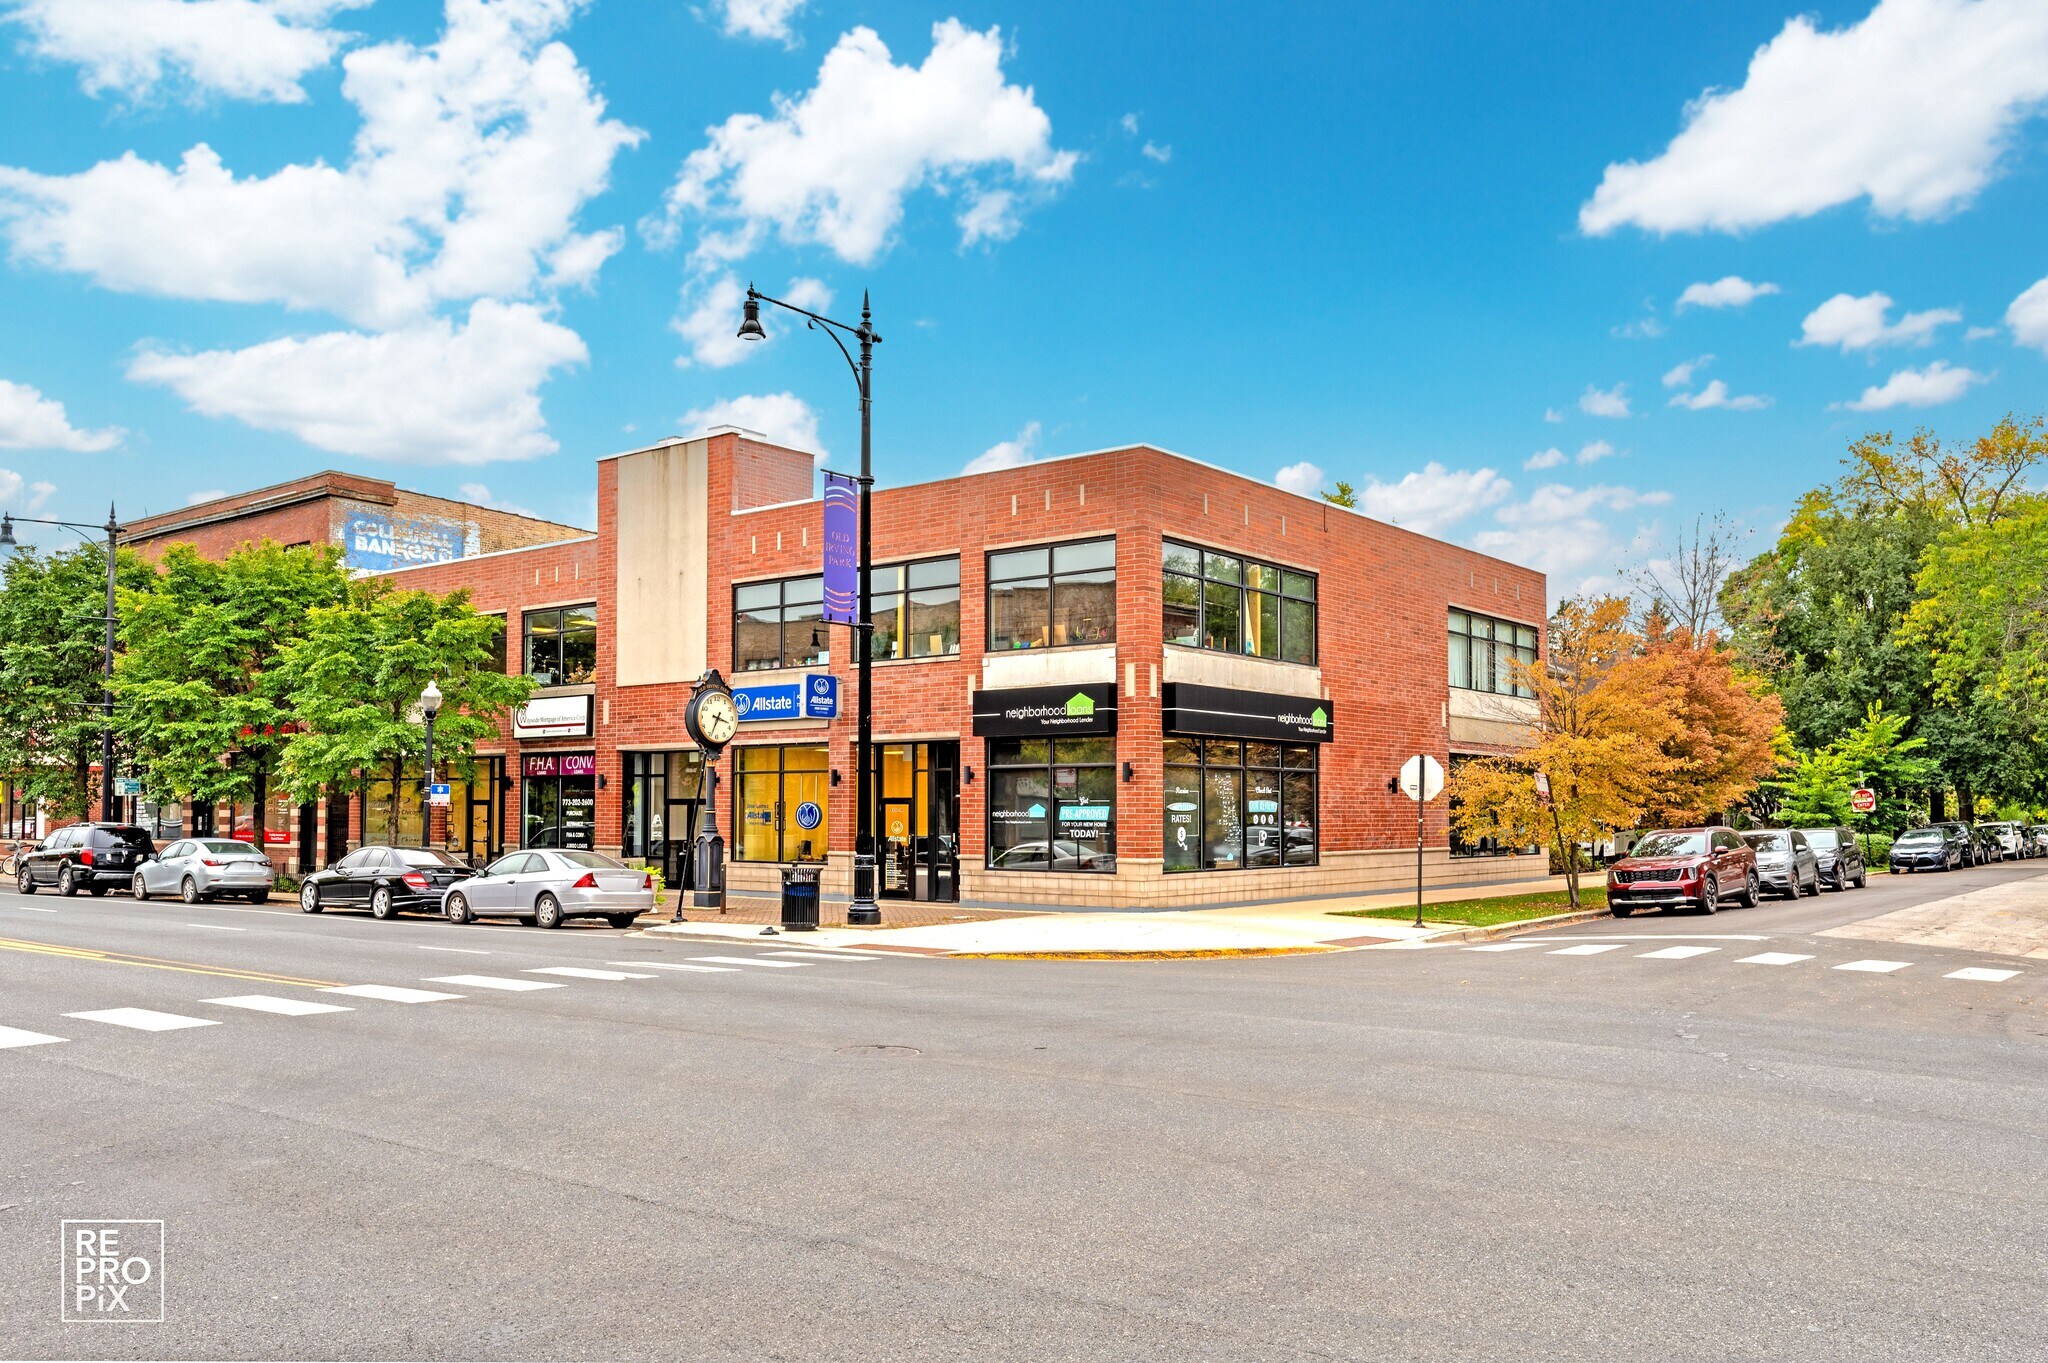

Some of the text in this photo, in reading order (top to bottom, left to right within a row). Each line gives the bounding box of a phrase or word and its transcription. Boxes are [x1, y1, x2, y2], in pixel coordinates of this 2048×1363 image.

[832, 531, 850, 543] OLD
[826, 543, 855, 556] IRVING
[829, 556, 852, 568] PARK
[752, 695, 792, 711] Allstate
[810, 696, 834, 705] Allstate
[1006, 704, 1094, 719] neighborhood loans
[1278, 713, 1313, 725] neighborhood
[530, 756, 594, 771] F.H.A. CONV.
[992, 809, 1030, 819] neighborhood
[1062, 808, 1107, 819] PRE-APPROVED
[1171, 814, 1192, 823] RATES!
[1070, 829, 1099, 838] TODAY!
